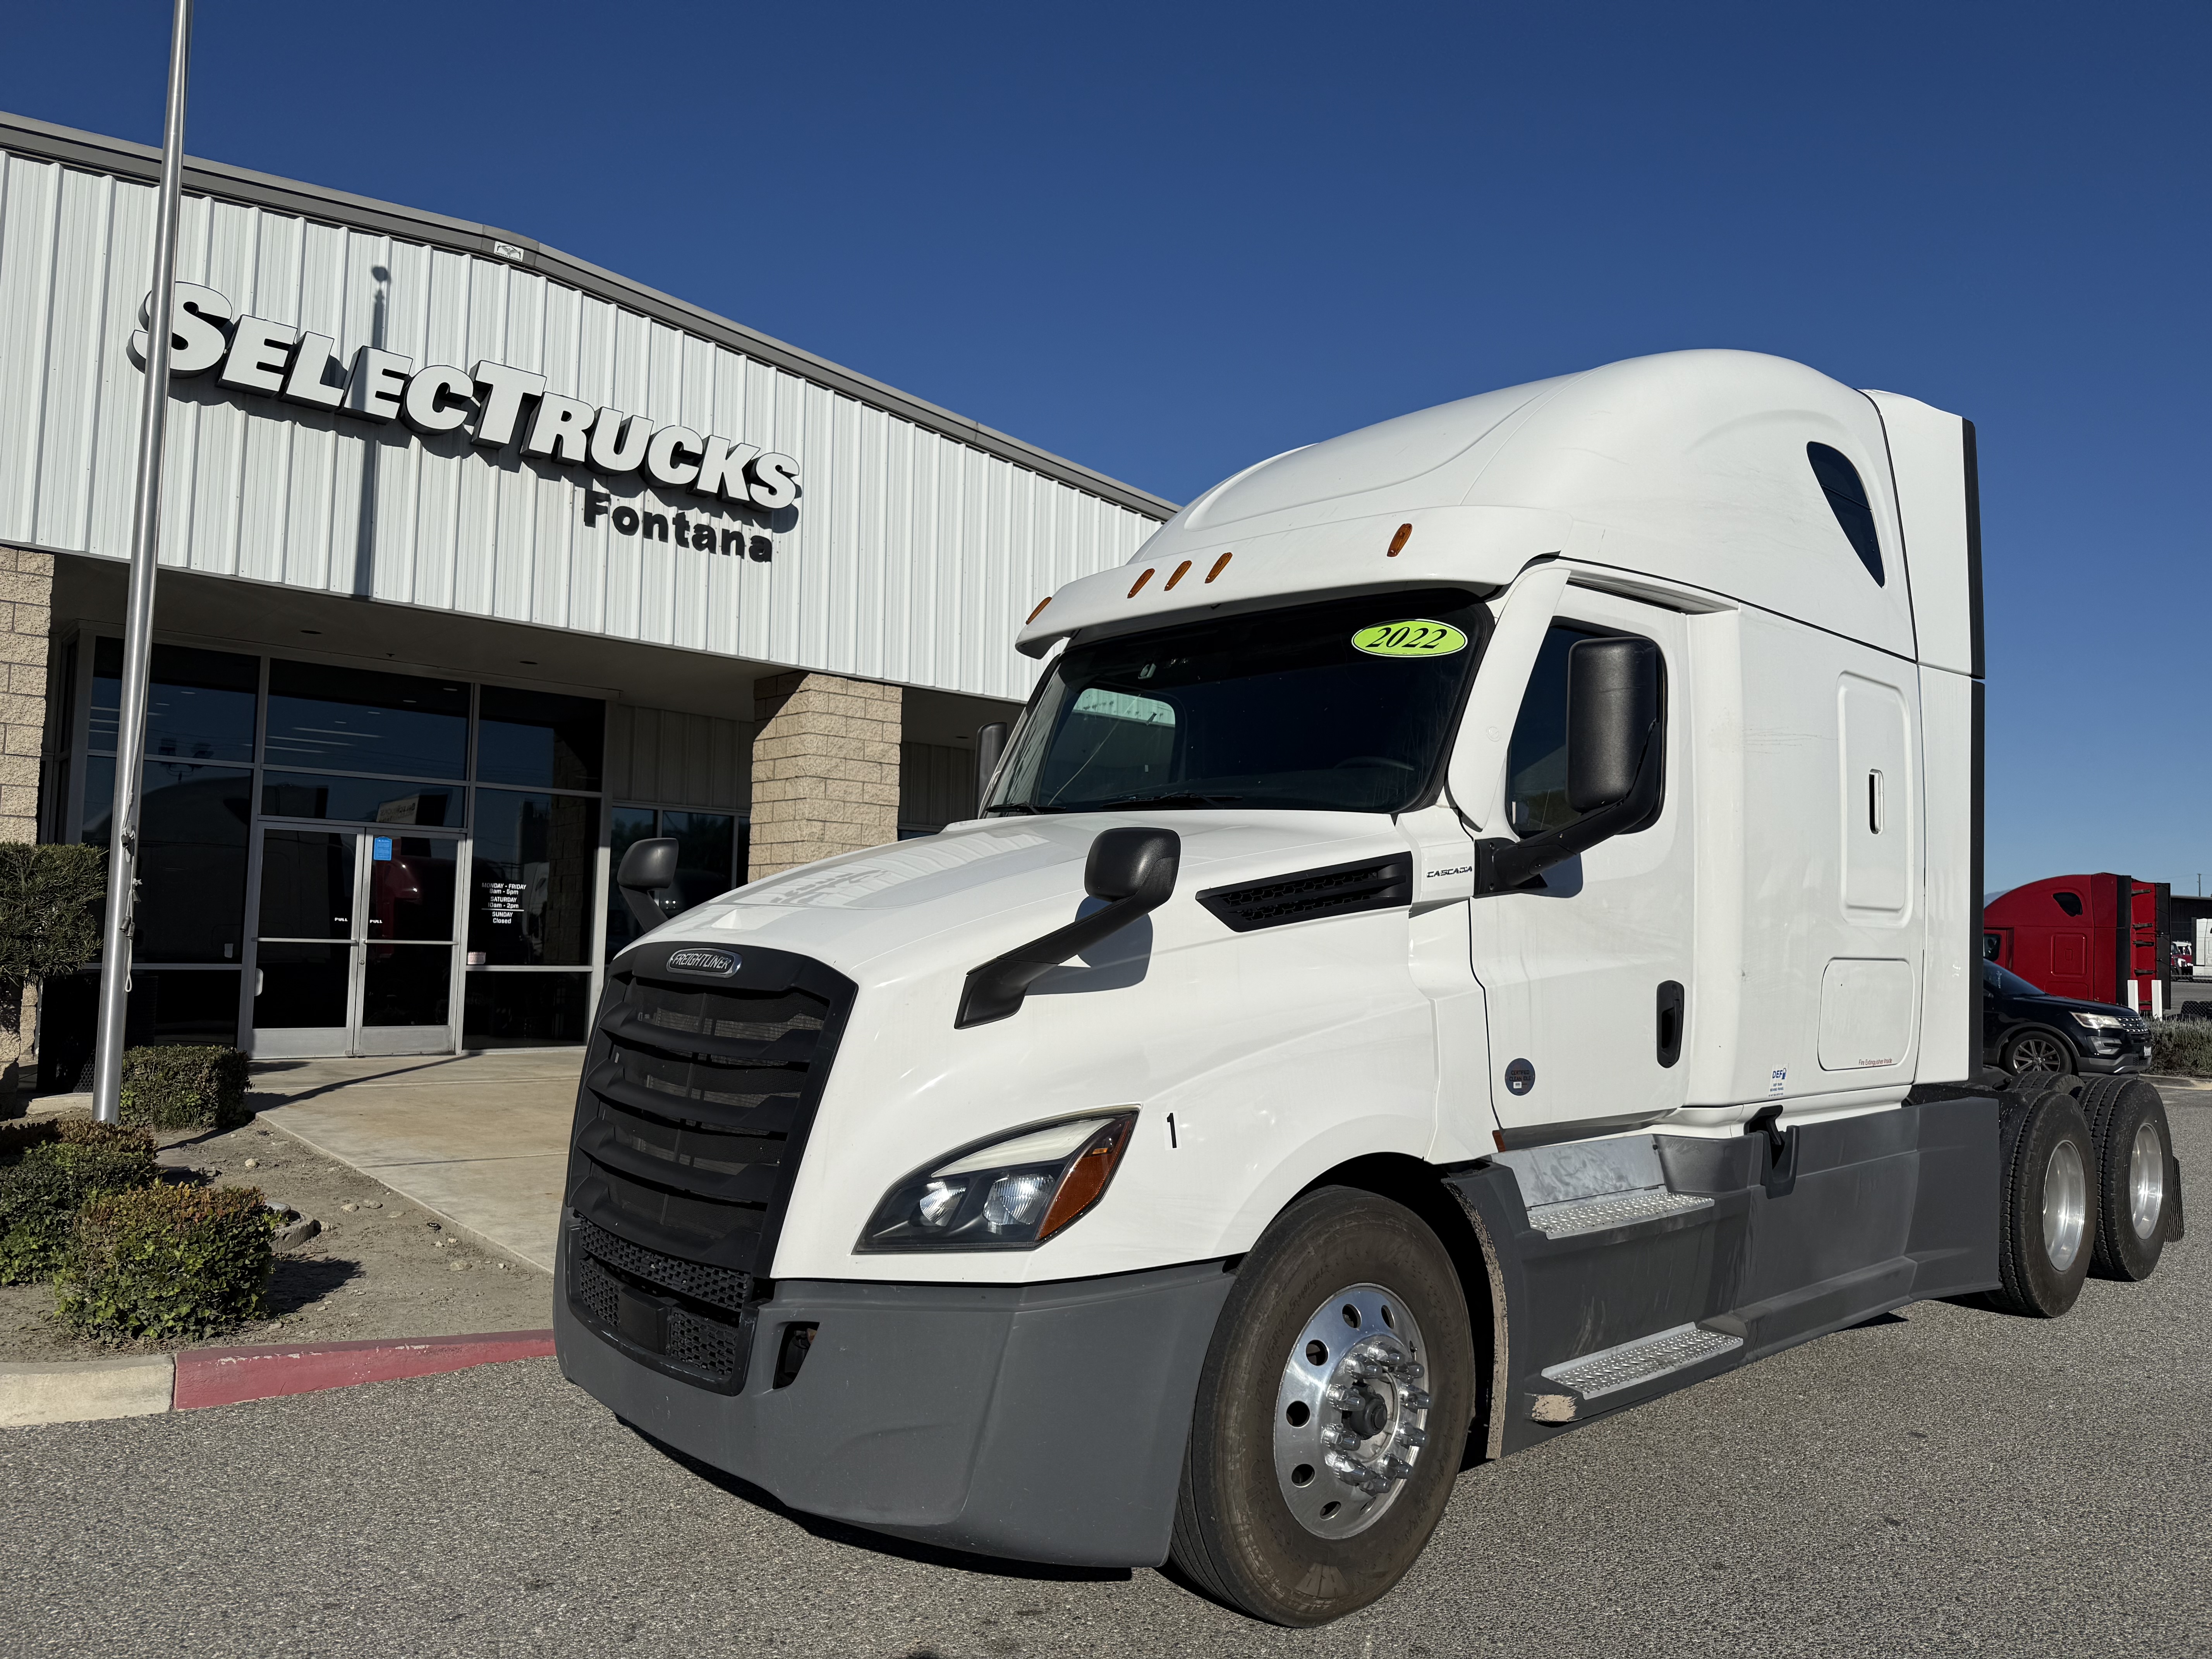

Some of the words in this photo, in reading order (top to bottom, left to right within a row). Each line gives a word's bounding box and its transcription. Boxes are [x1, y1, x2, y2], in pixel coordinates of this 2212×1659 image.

[127, 281, 800, 510] SELECTRUCKS
[583, 489, 773, 563] Fontana
[1365, 627, 1448, 649] 2022
[672, 953, 732, 969] FREIGHTLINER
[1772, 1070, 1783, 1079] DEF
[1166, 1112, 1177, 1149] 1
